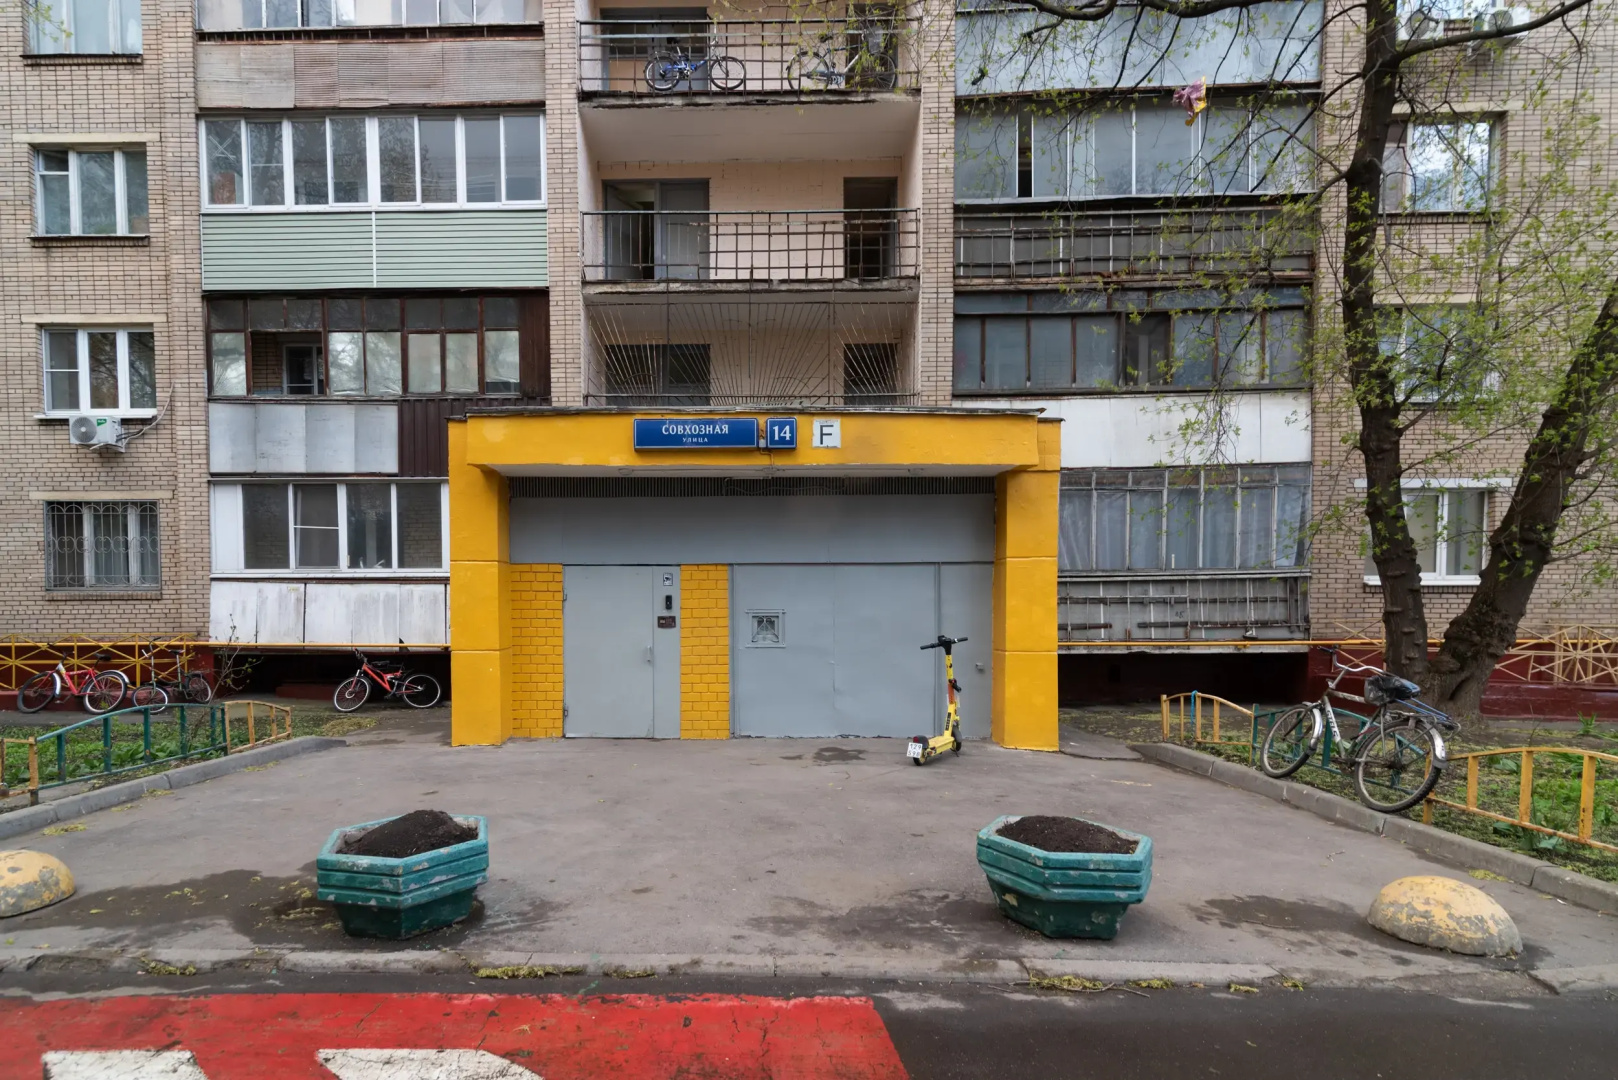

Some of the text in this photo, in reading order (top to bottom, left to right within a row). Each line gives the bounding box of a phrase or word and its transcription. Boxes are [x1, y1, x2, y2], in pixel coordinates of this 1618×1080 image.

[662, 424, 729, 435] СОВХОЗНАЯ
[772, 425, 792, 441] 14
[820, 424, 834, 445] F
